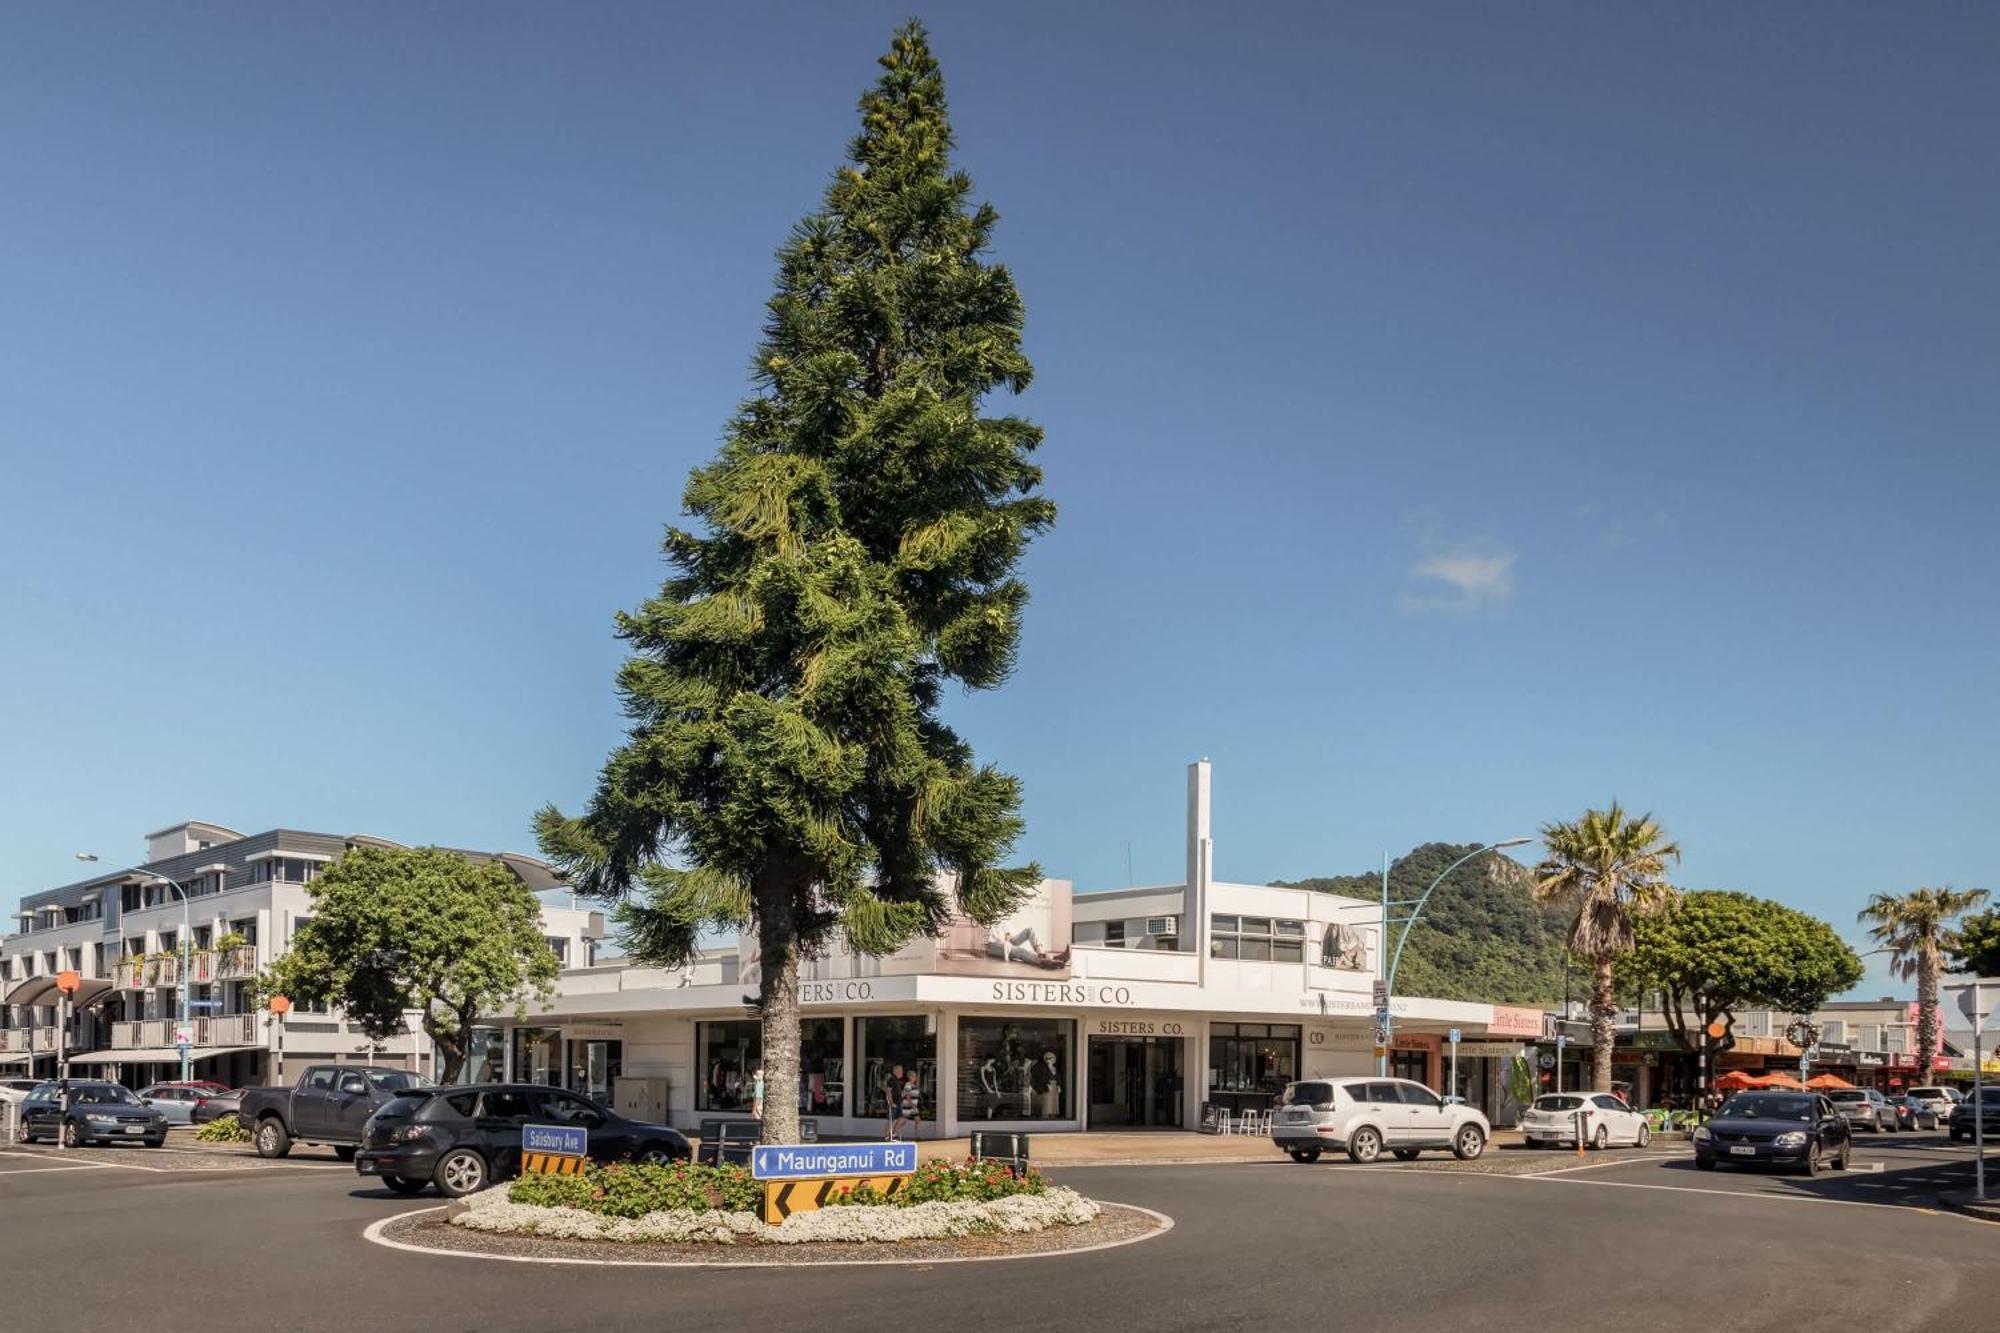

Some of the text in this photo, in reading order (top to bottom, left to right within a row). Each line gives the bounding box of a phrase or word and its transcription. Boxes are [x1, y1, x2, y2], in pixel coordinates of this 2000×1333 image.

[846, 981, 875, 1000] CO.
[992, 982, 1086, 1003] SISTERS
[1099, 986, 1135, 1006] CO.
[1099, 1021, 1185, 1035] SISTERS CO.
[530, 1130, 579, 1151] Salisbury Ave
[778, 1149, 905, 1173] Maunganui Rd
